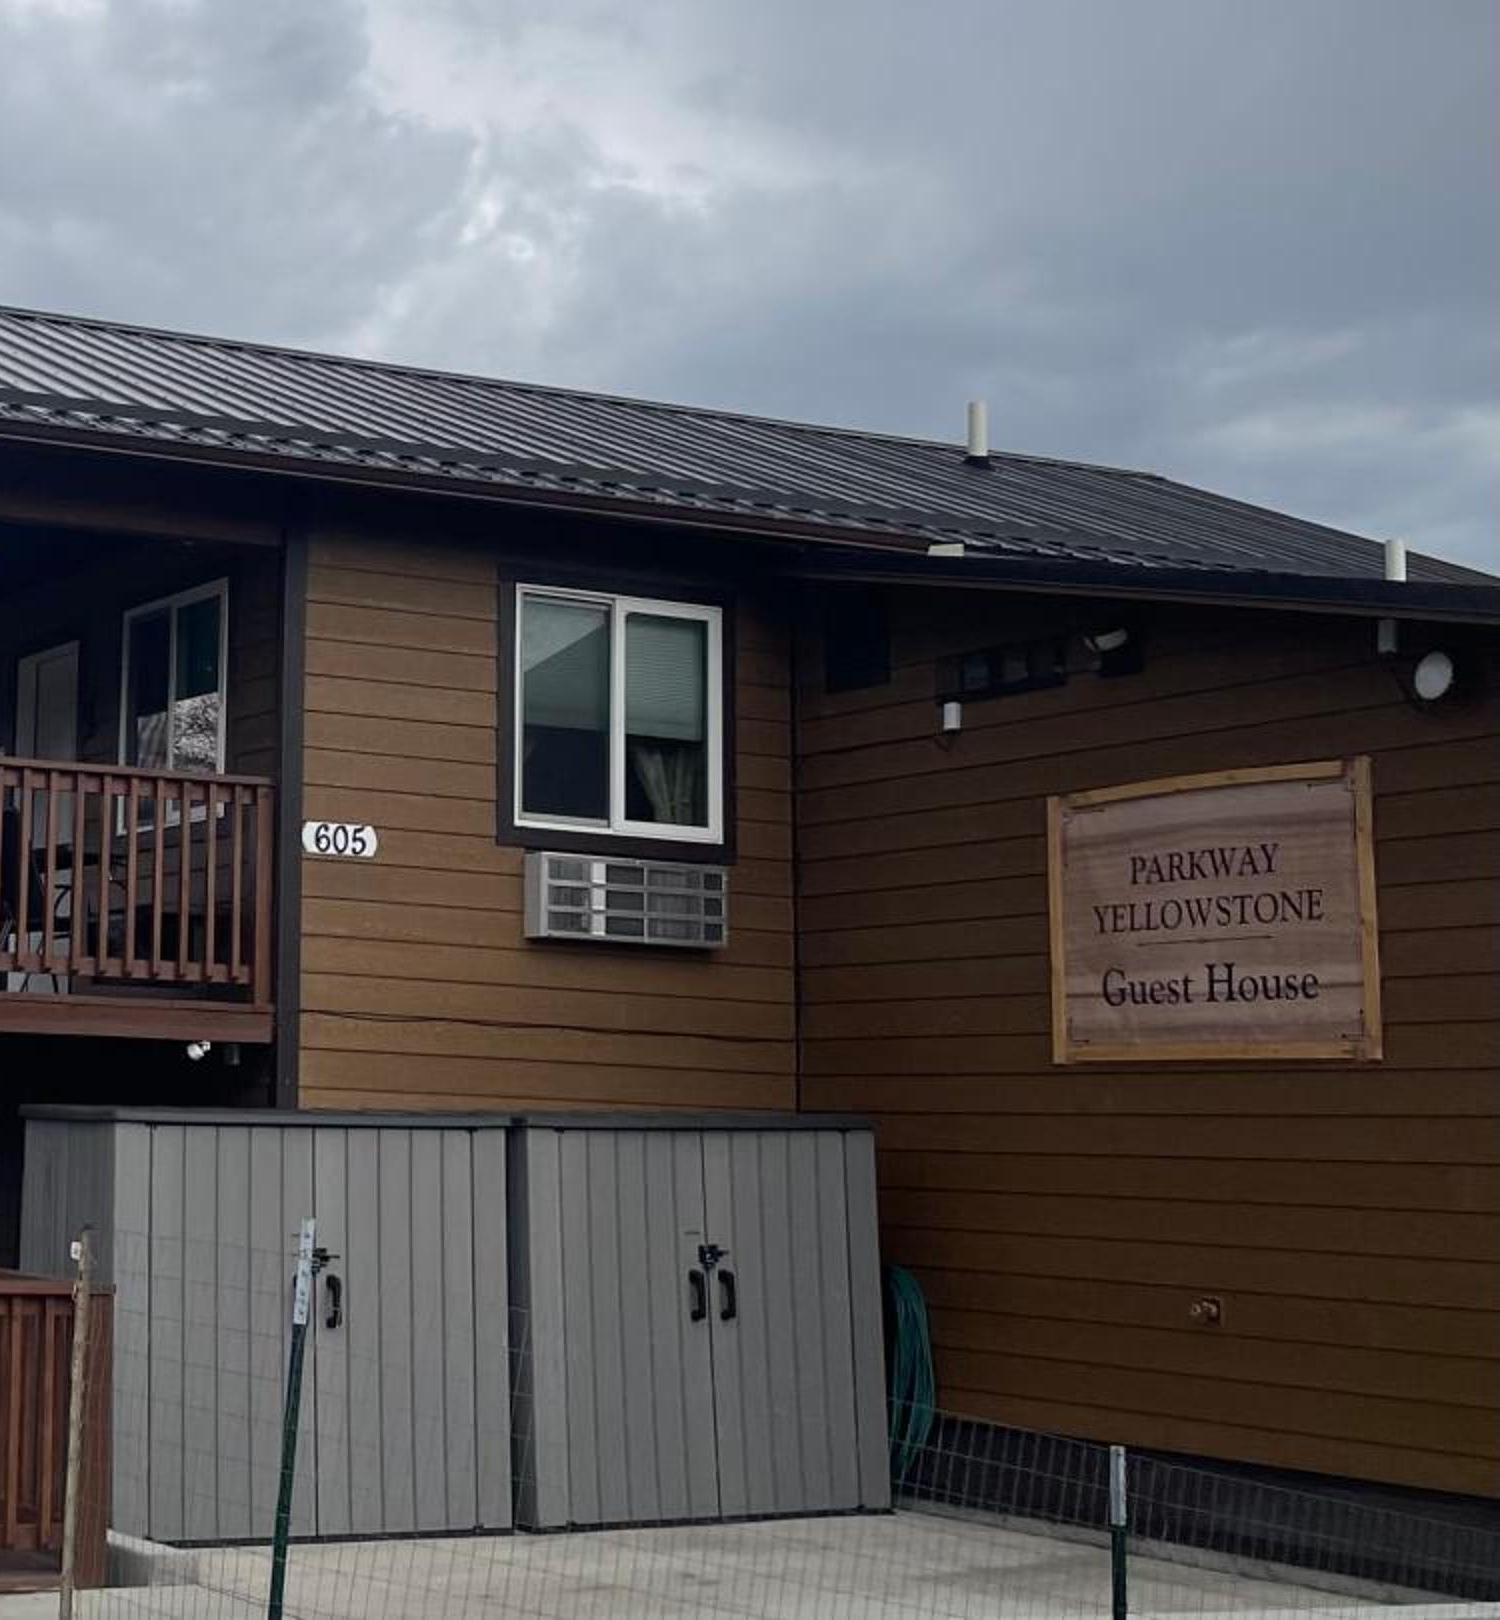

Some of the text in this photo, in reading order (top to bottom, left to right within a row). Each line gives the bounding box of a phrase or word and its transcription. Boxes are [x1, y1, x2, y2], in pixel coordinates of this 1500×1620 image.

[315, 824, 367, 855] 605
[1129, 843, 1279, 885] PARKWAY
[1092, 889, 1325, 934] YELLOWSTONE
[1102, 962, 1320, 1007] Guest House
